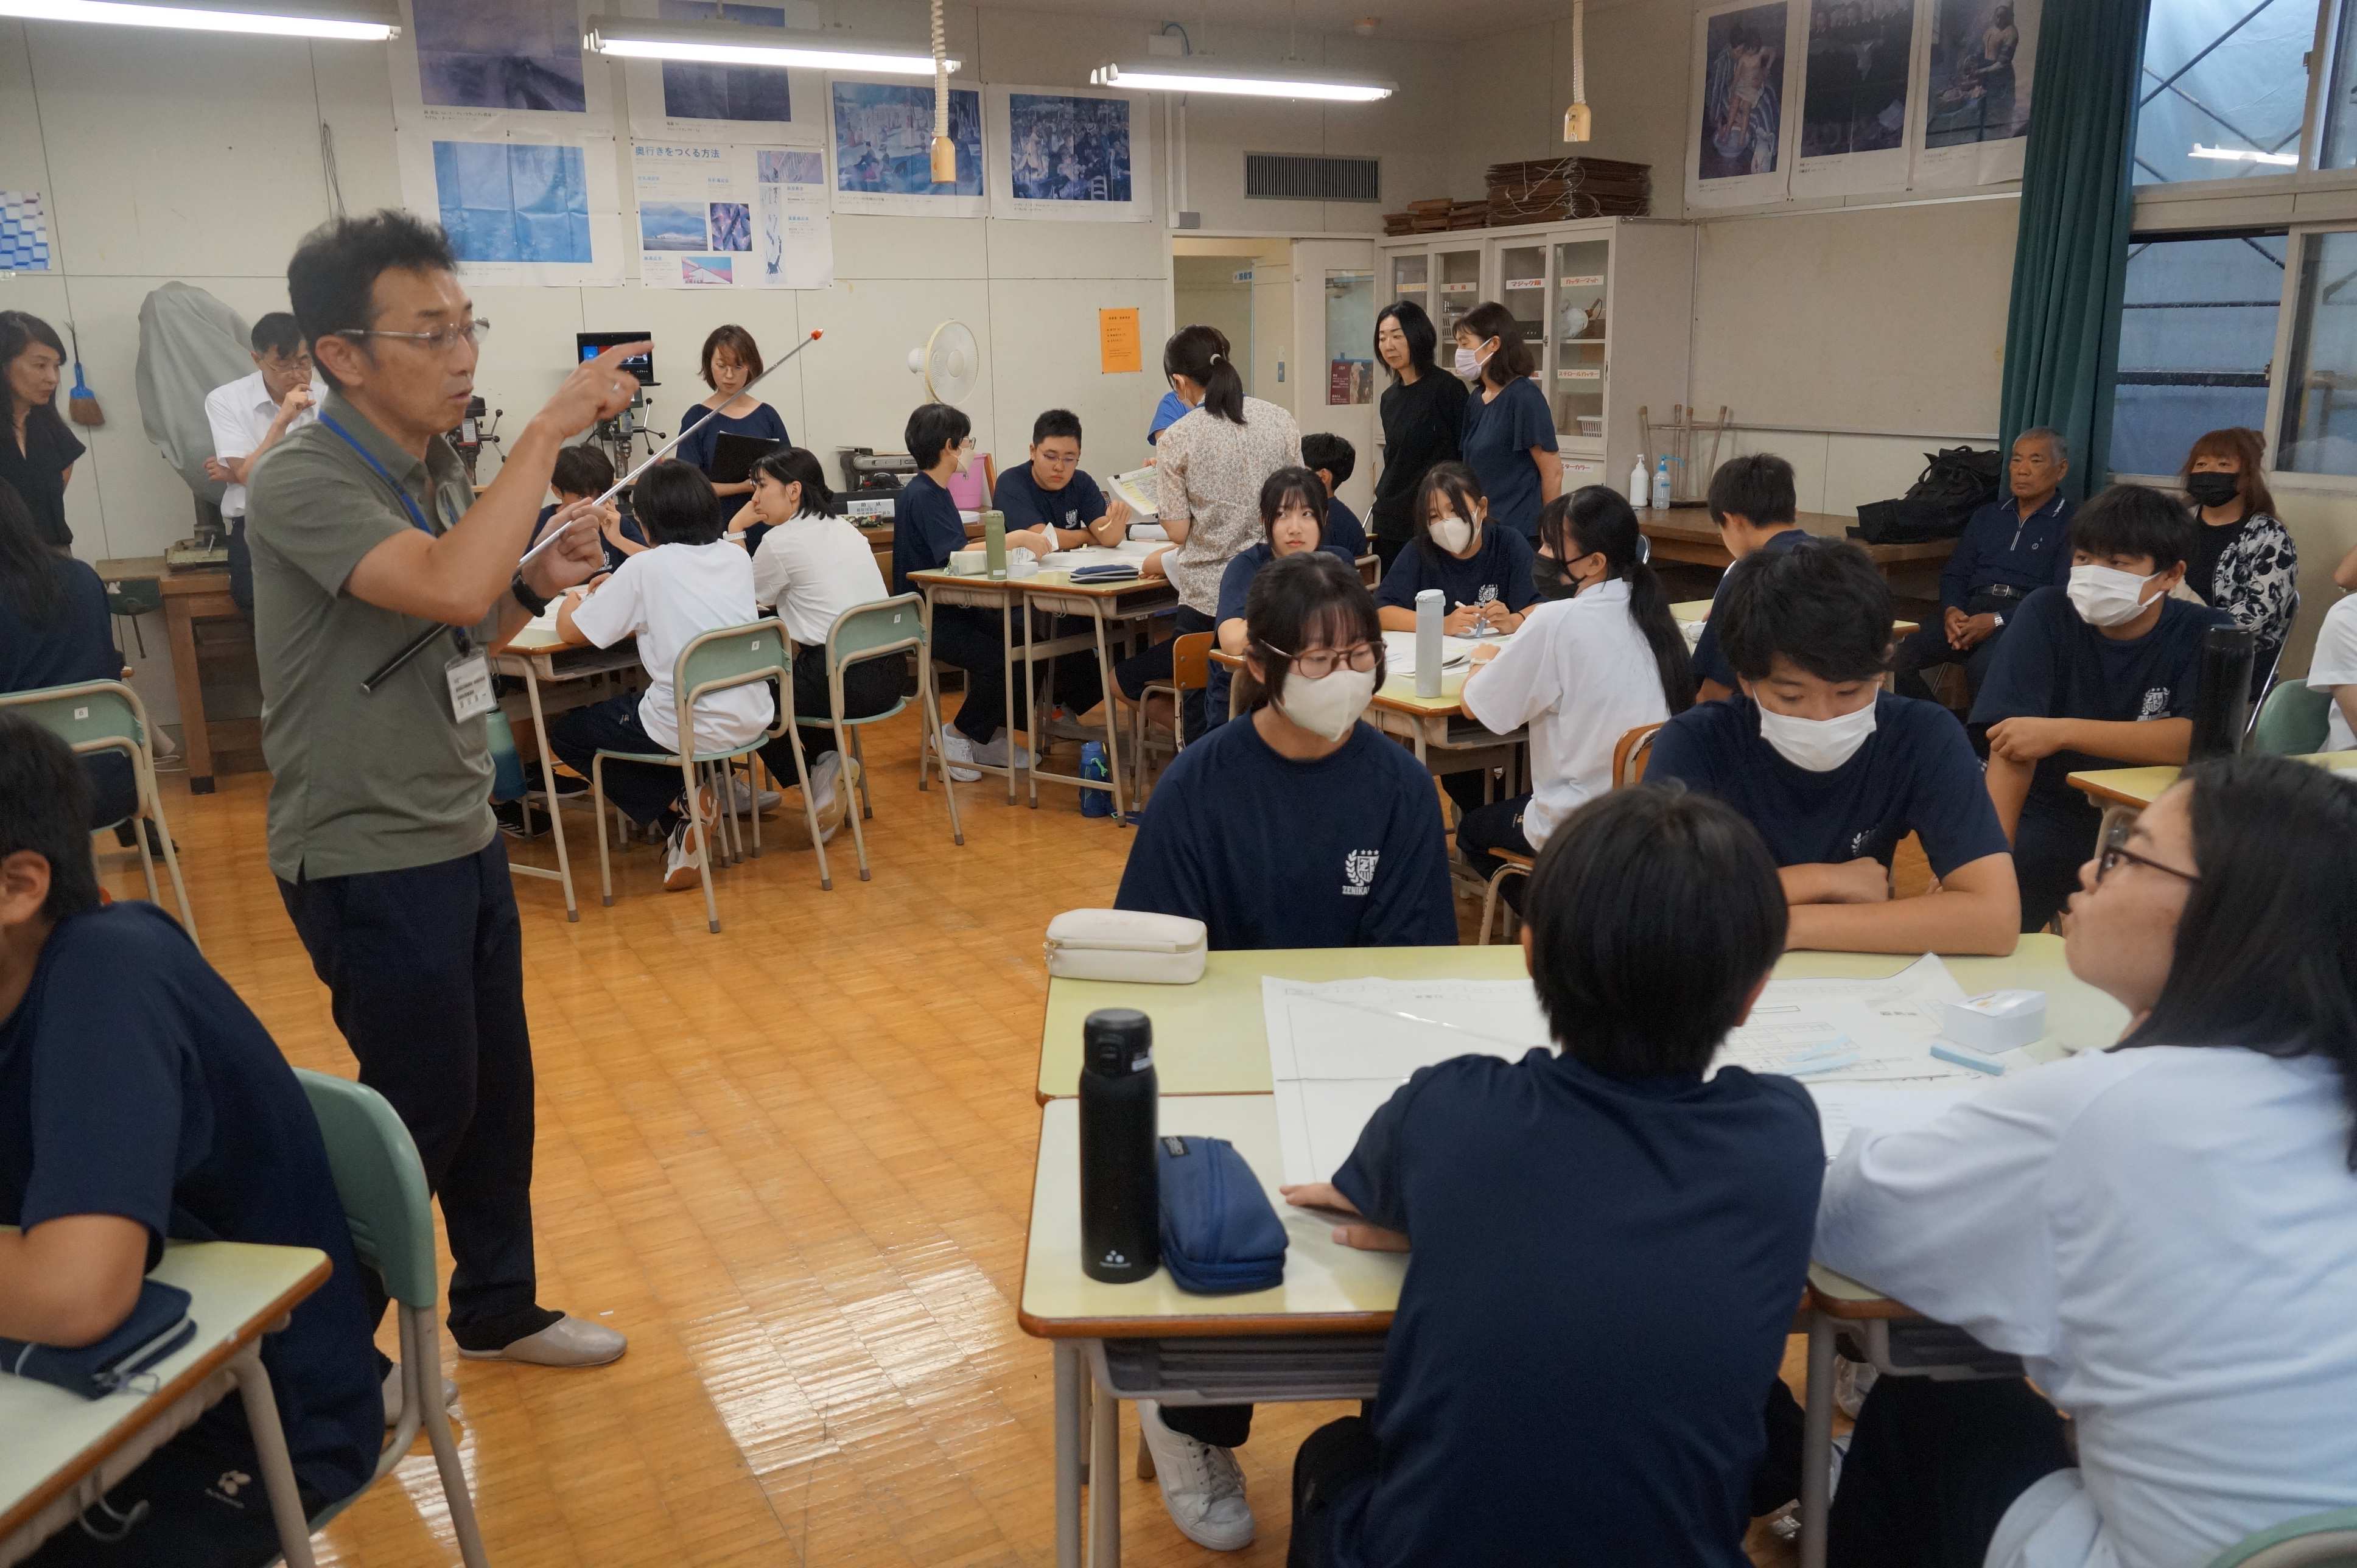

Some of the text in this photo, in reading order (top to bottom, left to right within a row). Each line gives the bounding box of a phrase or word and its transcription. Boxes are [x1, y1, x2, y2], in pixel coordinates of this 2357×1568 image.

[636, 146, 720, 158] 奥行きをつくる方法
